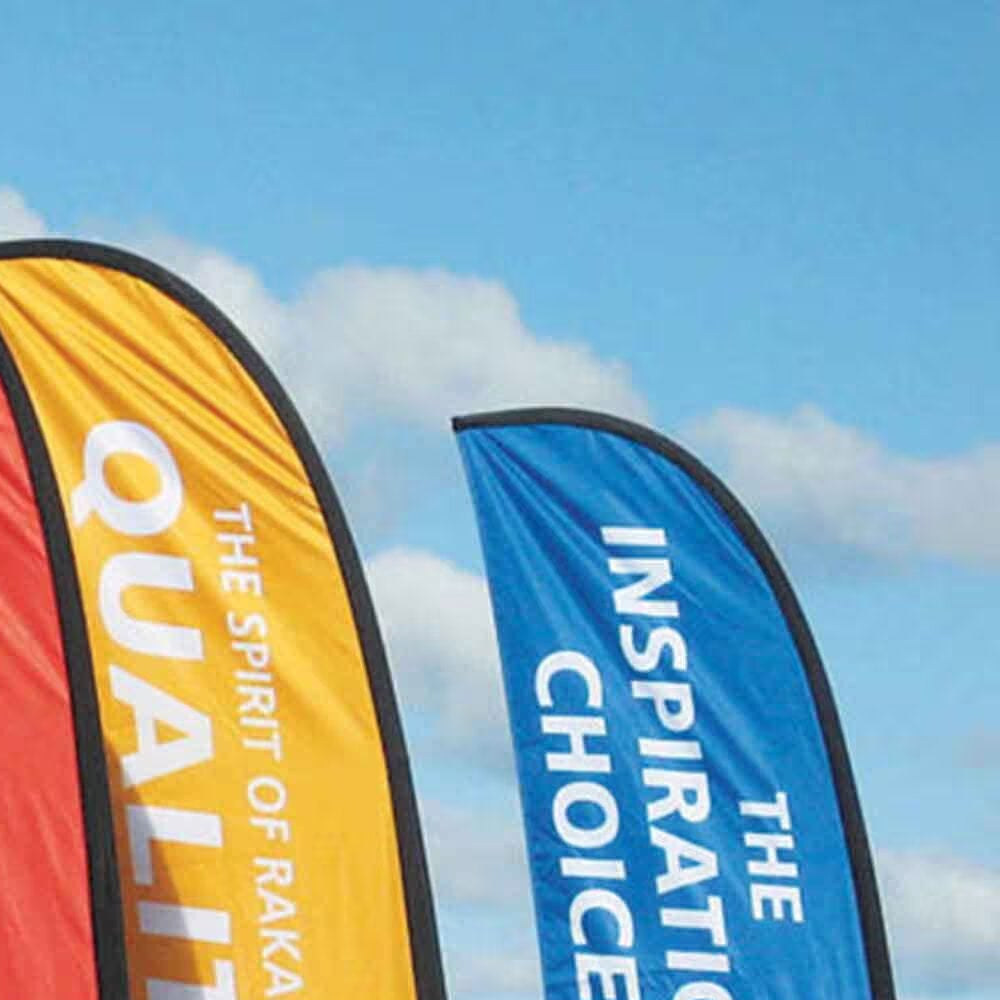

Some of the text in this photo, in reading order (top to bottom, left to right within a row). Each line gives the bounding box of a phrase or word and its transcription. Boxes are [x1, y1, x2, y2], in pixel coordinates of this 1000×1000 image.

[213, 502, 263, 598] THE
[226, 611, 283, 762] SPIRIT
[247, 775, 290, 843] OF
[738, 791, 804, 922] THE
